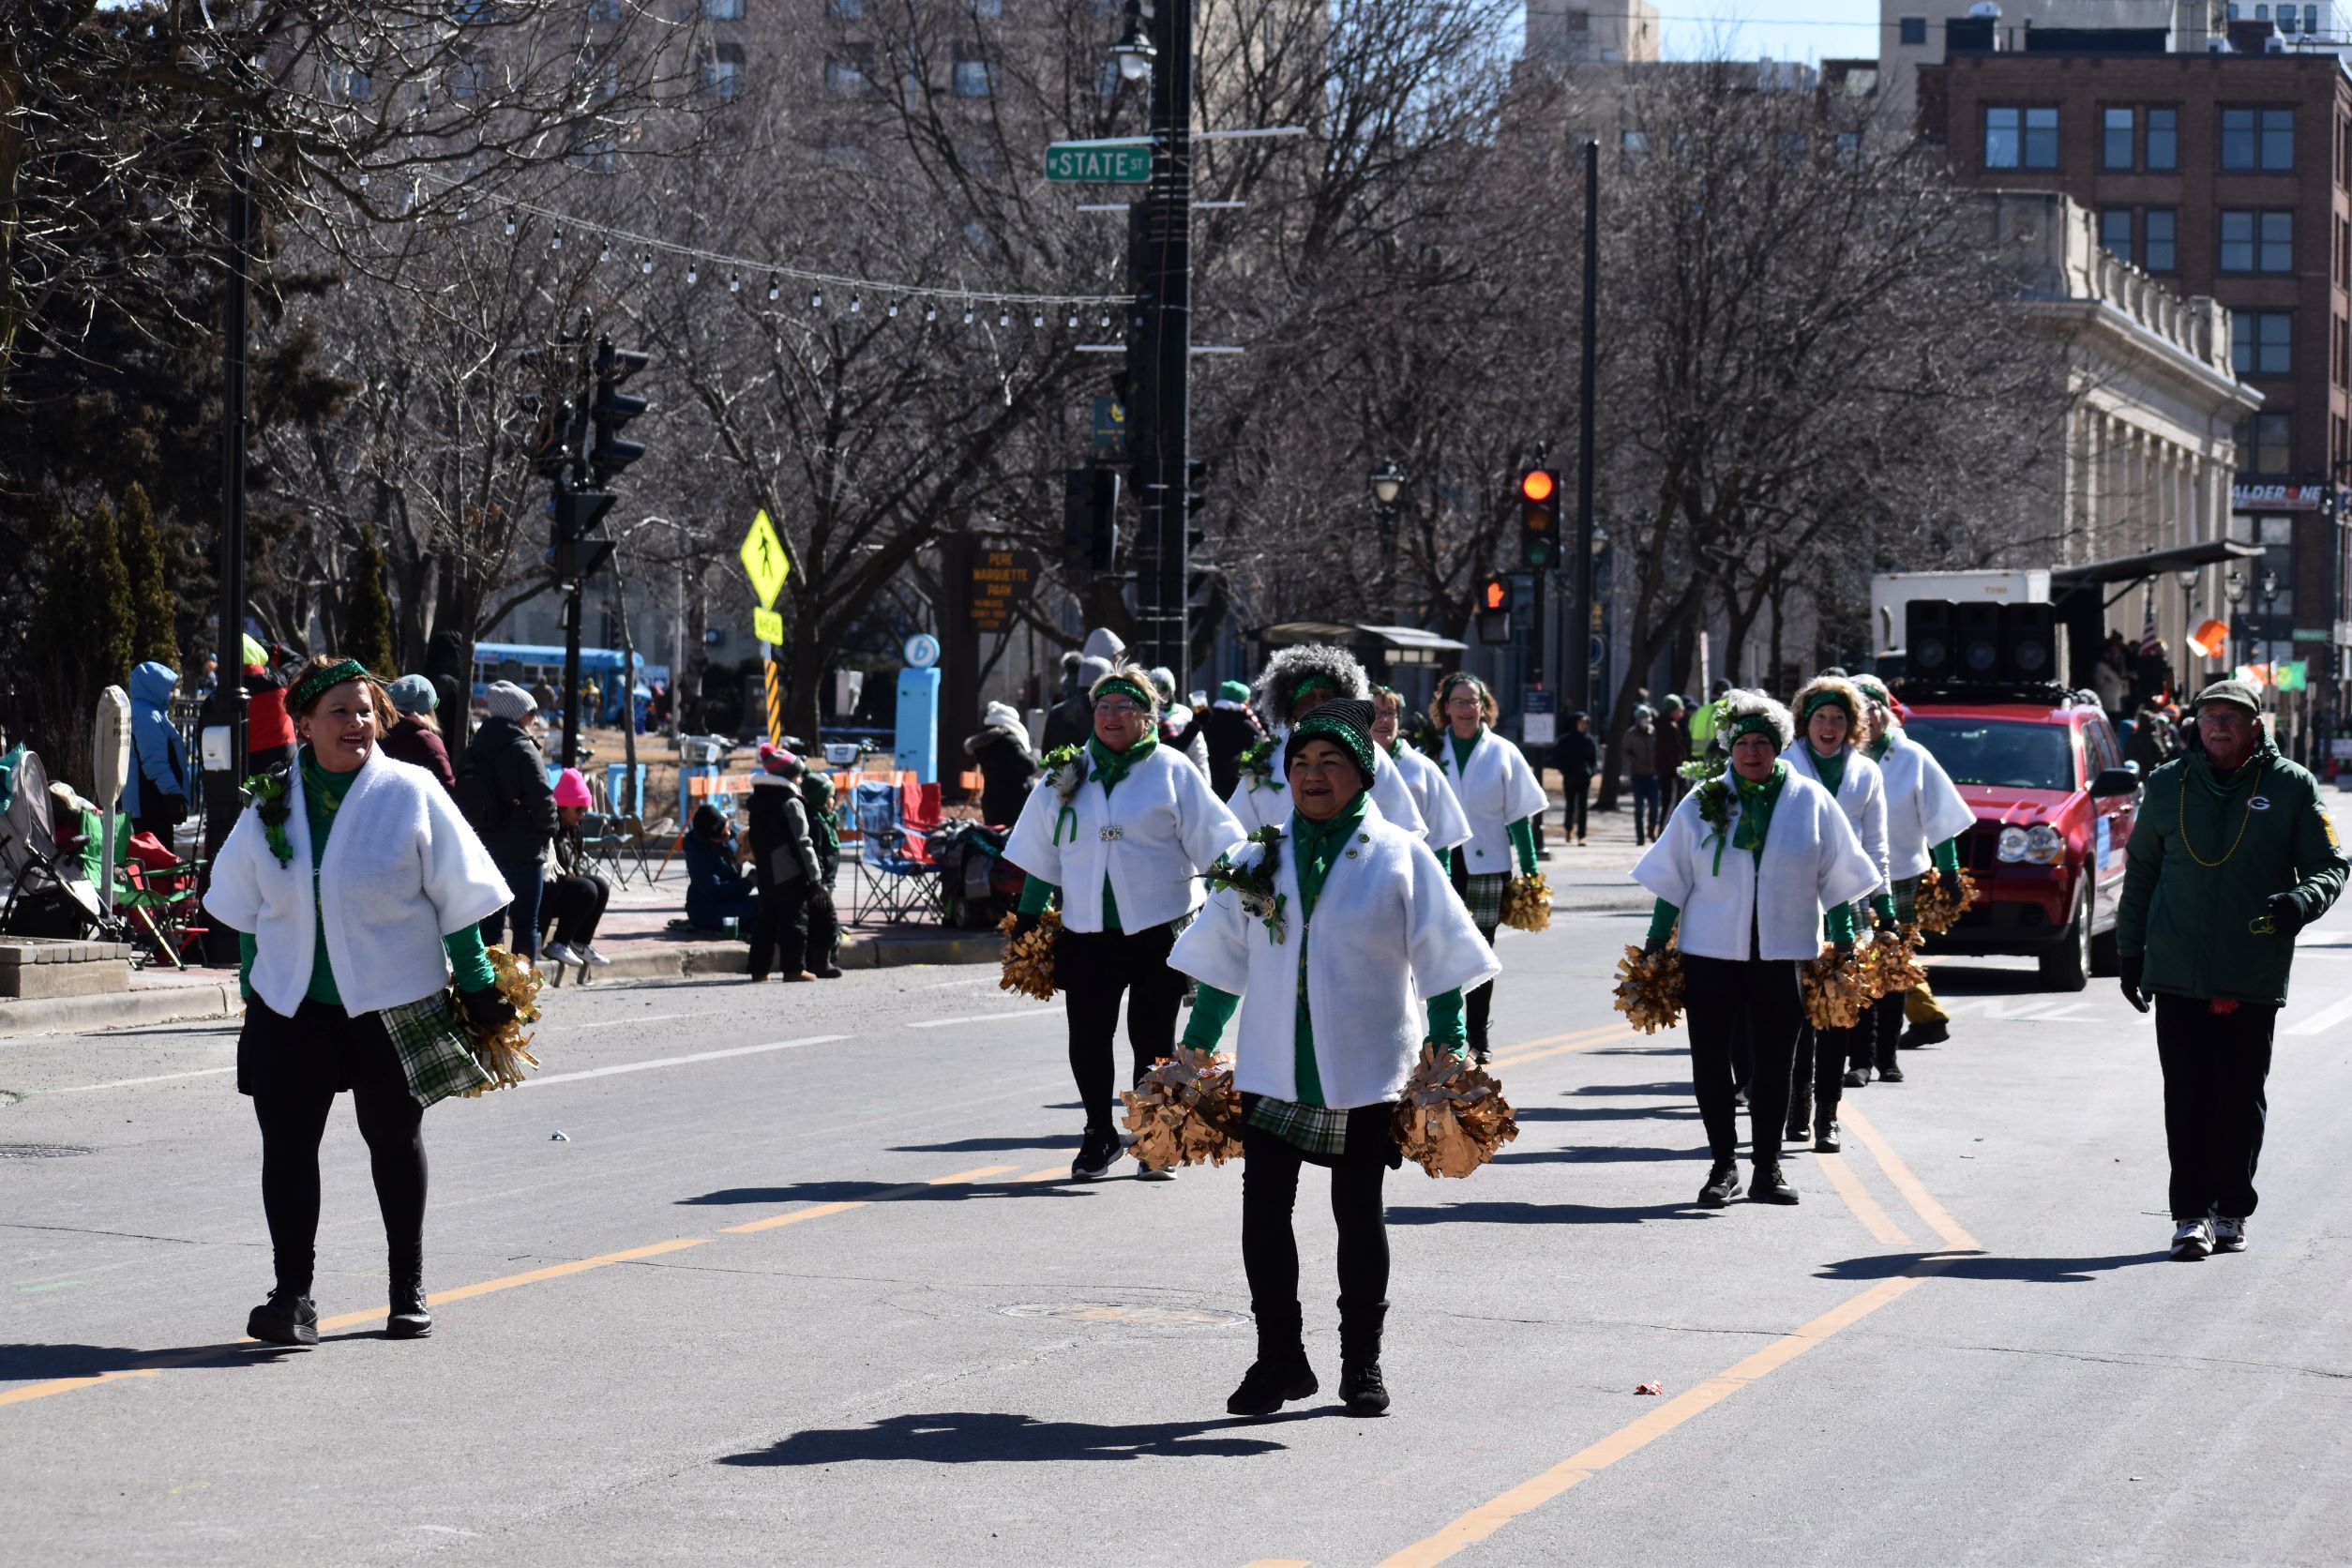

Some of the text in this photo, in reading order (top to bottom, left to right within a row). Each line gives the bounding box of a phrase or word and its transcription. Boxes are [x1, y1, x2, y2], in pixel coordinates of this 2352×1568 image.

[1048, 152, 1143, 176] W STATE ST
[988, 552, 1014, 565] PERE
[972, 568, 1029, 581] MARQUETTE
[987, 583, 1013, 596] PARK
